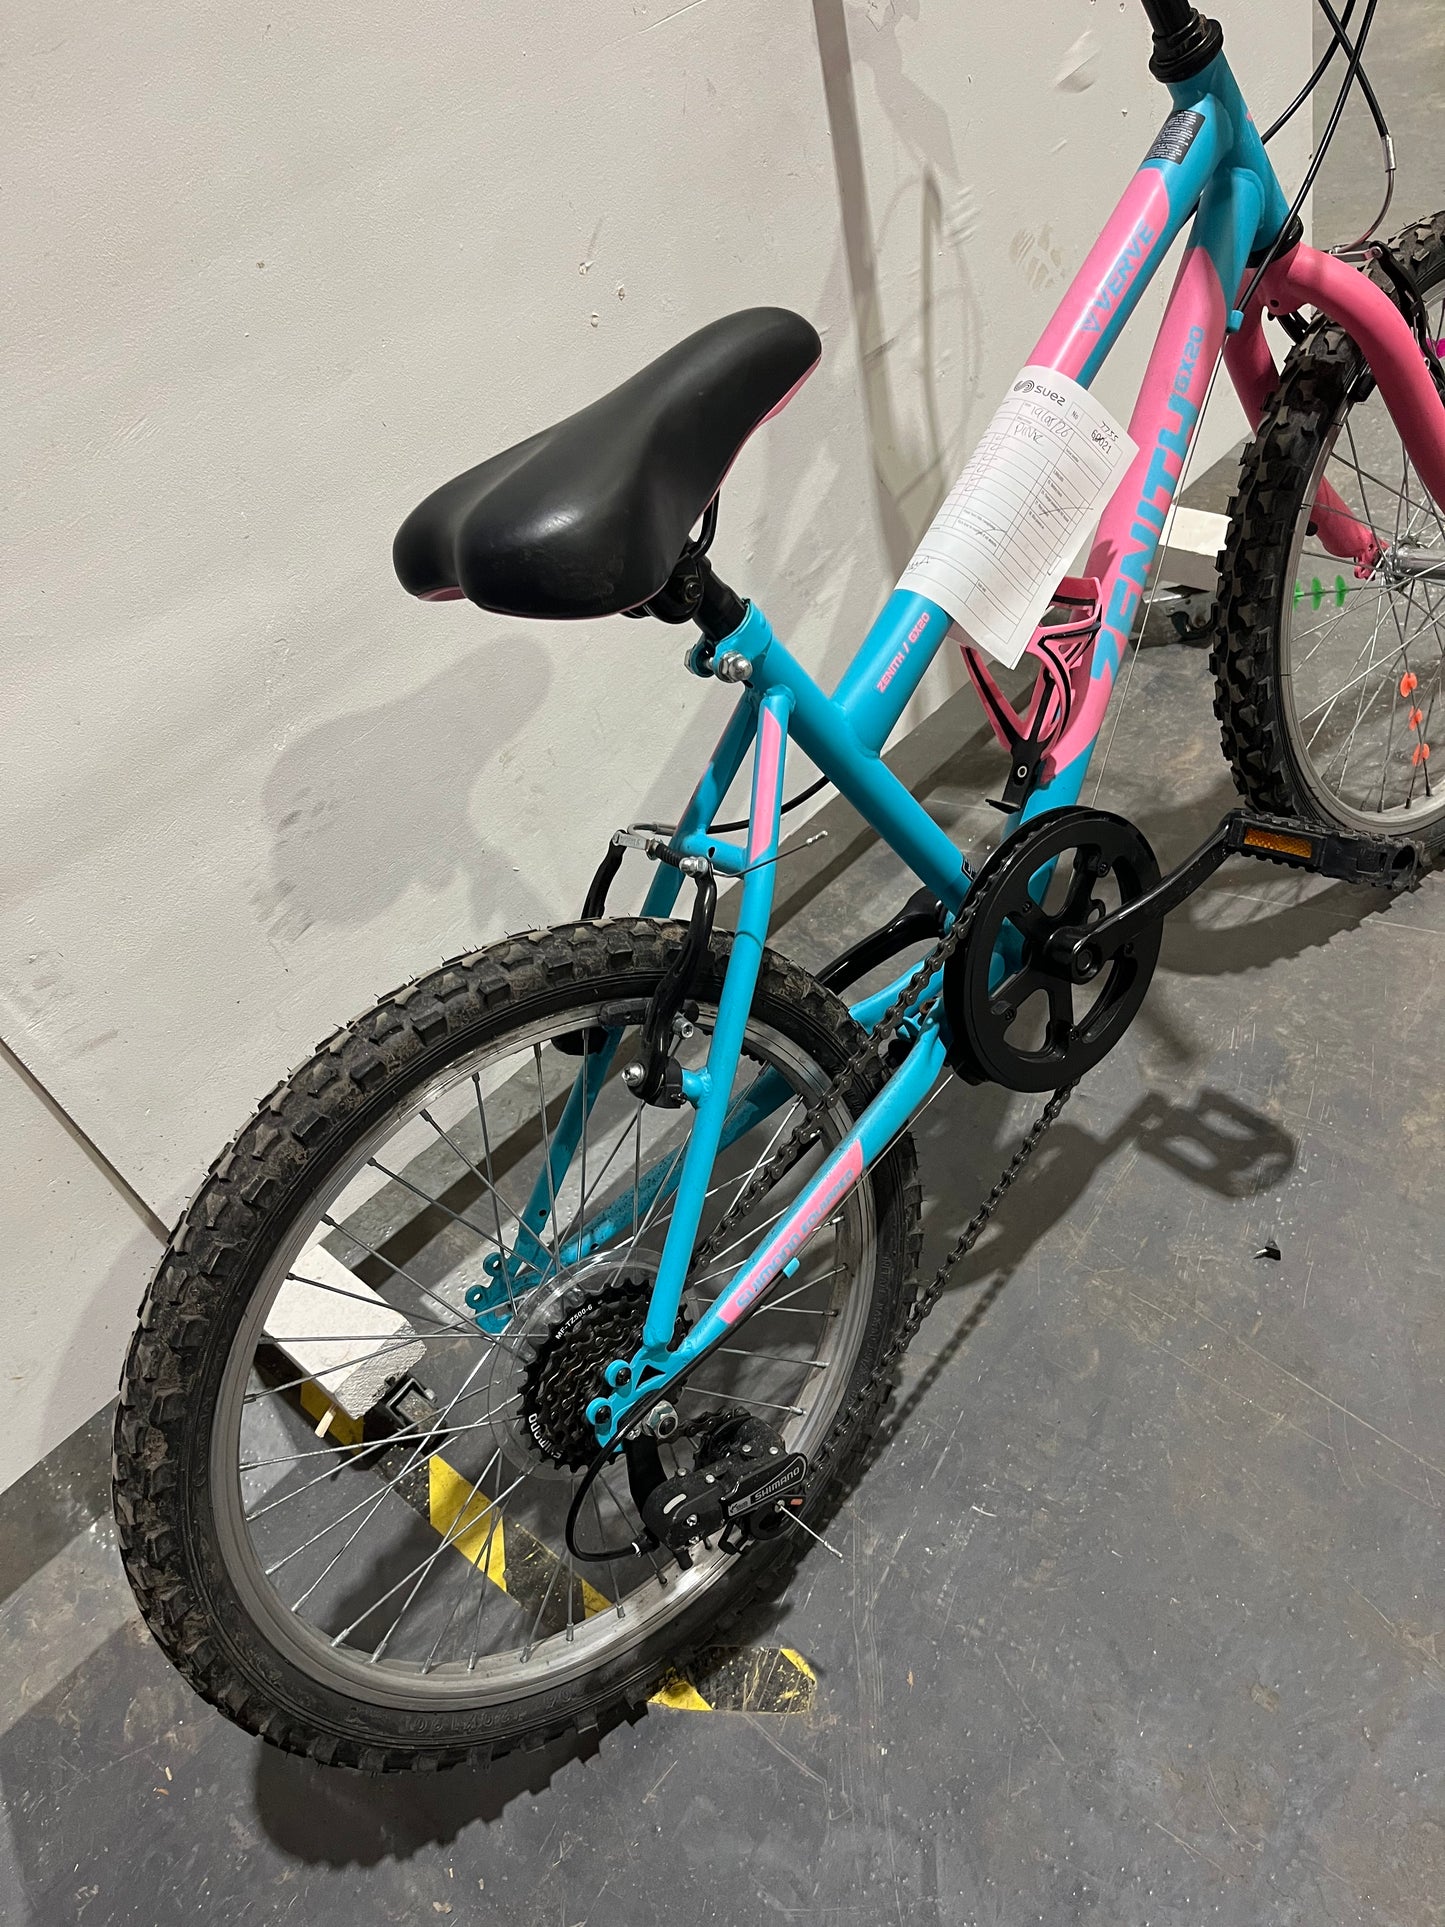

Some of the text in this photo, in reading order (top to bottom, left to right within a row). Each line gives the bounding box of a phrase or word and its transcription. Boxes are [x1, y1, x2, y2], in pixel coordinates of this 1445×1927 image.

[1095, 218, 1155, 311] VERVE
[1034, 384, 1066, 406] suez
[1173, 325, 1205, 394] GX20
[1090, 391, 1201, 685] ZENITH
[876, 652, 906, 693] ZENITH
[908, 611, 931, 643] GX20
[735, 1168, 855, 1309] SHIMANO EQUIPPED
[754, 1467, 802, 1502] SHIMANO
